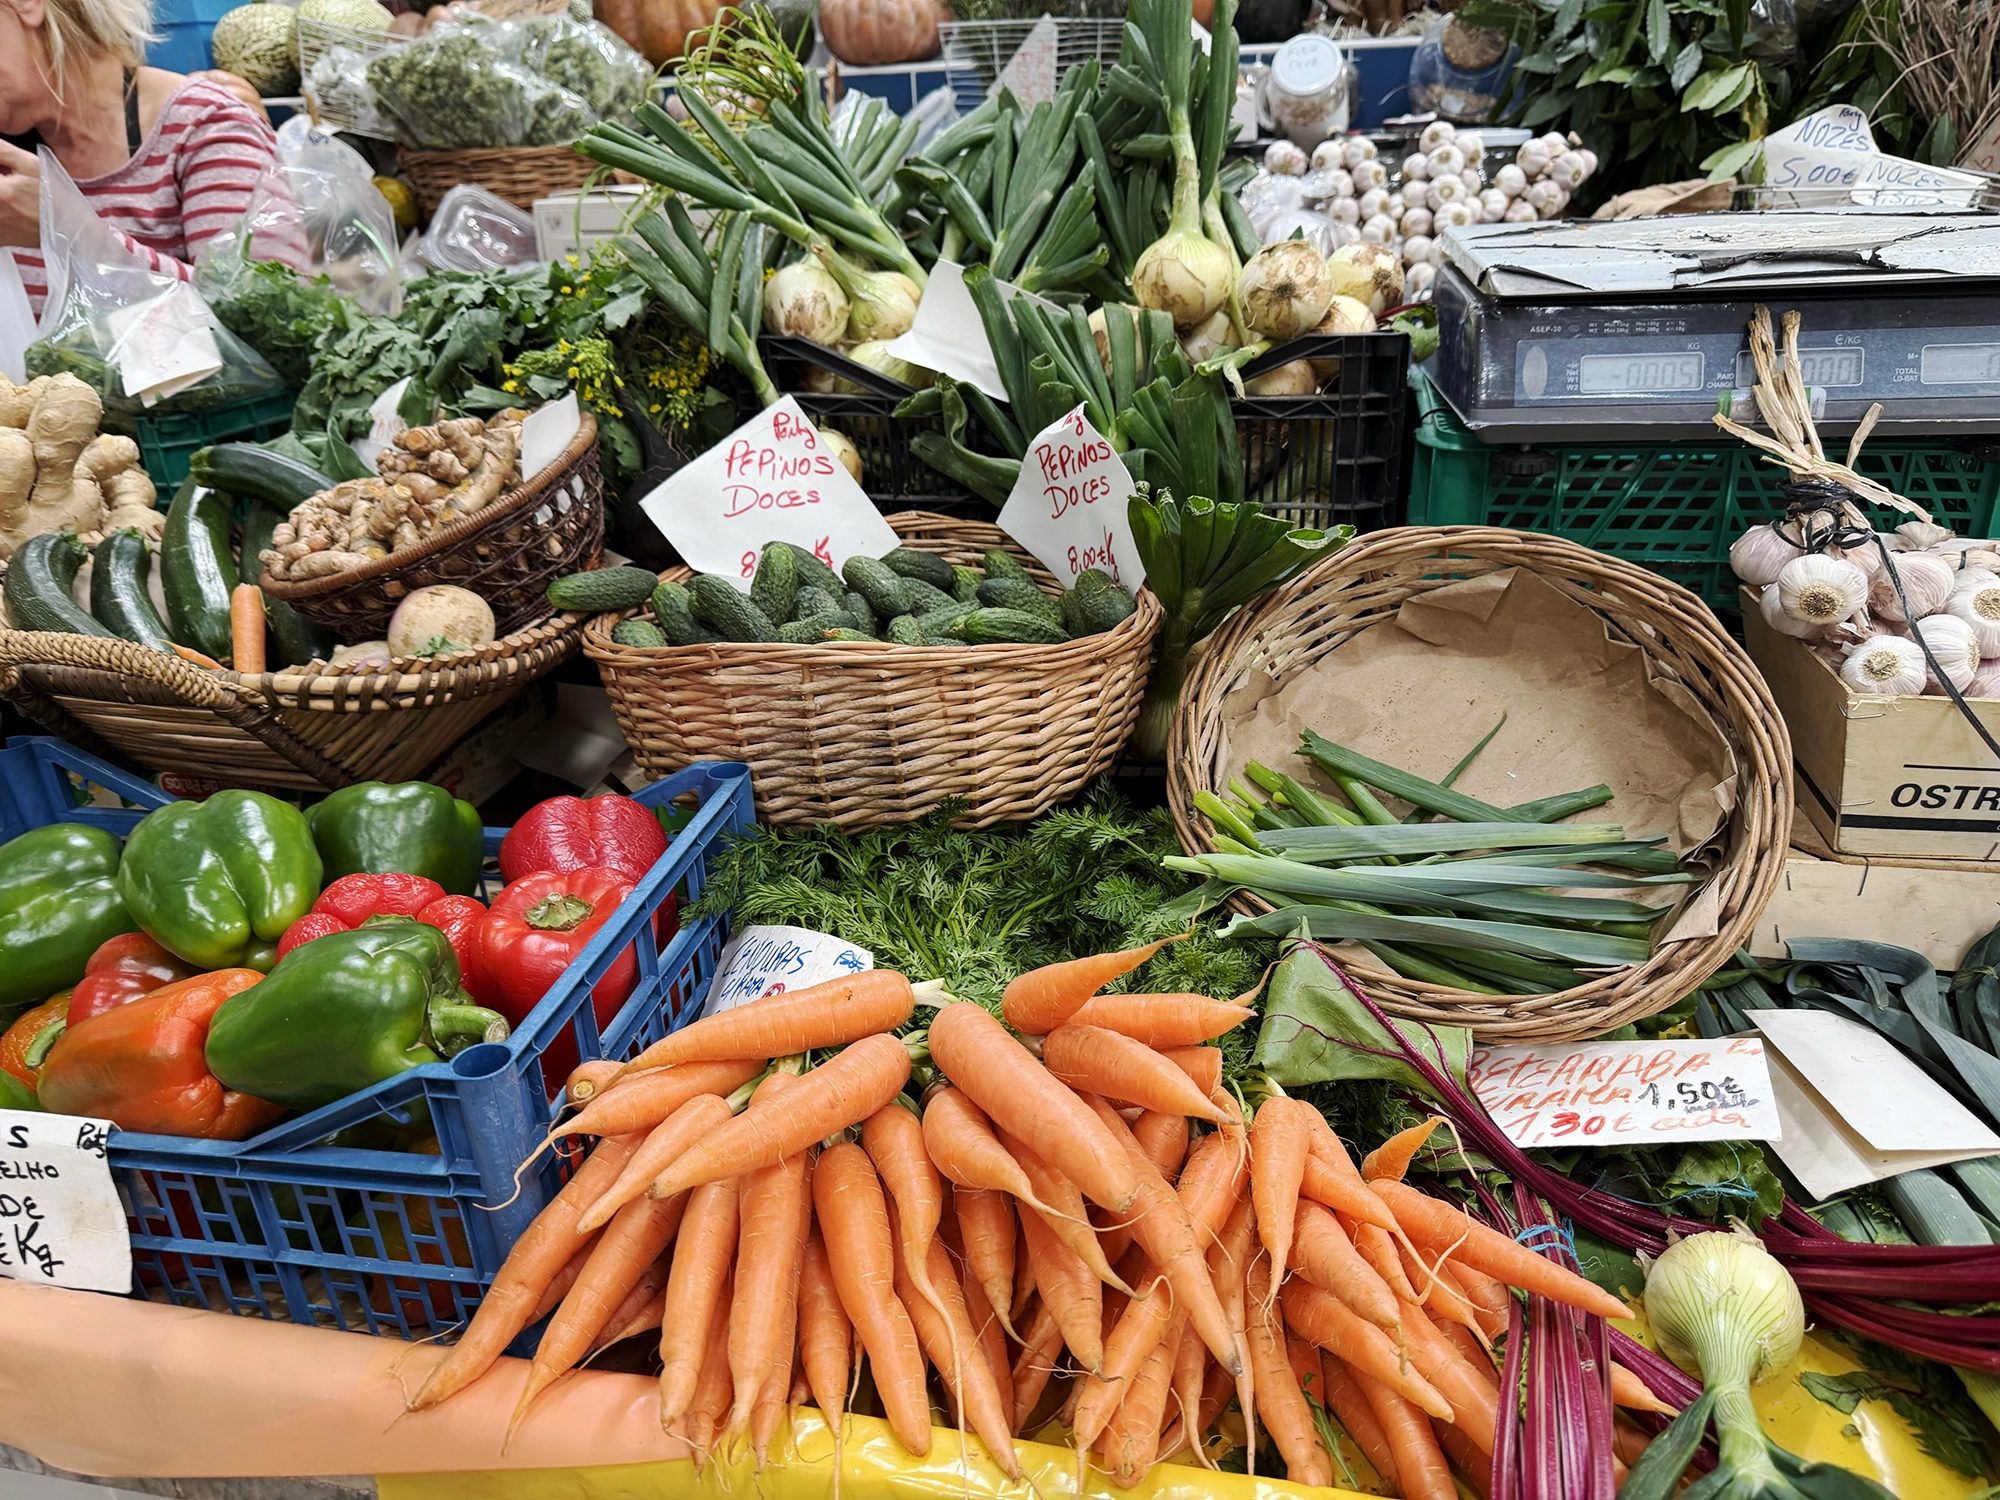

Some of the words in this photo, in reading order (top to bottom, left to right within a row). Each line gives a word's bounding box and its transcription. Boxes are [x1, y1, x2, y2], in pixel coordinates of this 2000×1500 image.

[1794, 116, 1869, 151] NOZES
[1687, 342, 1701, 351] KG
[1706, 380, 1734, 388] CHANGE
[1716, 372, 1735, 380] PAID
[722, 484, 821, 518] DOCES
[1043, 475, 1111, 519] DOCES
[741, 551, 756, 578] 8
[1890, 783, 2000, 810] OSTR
